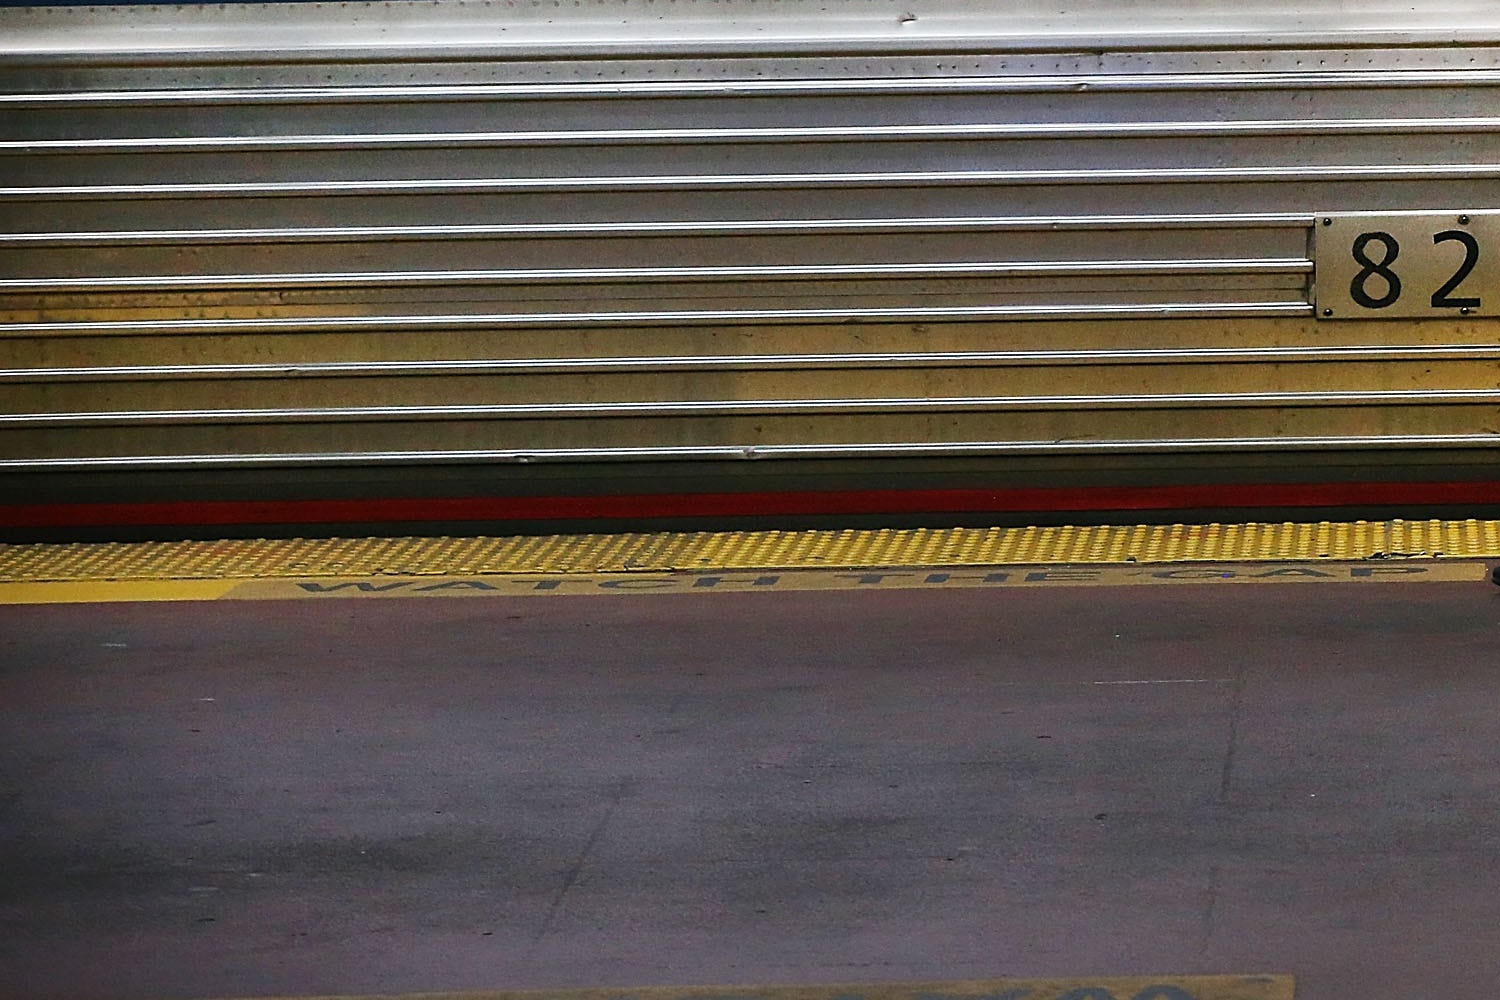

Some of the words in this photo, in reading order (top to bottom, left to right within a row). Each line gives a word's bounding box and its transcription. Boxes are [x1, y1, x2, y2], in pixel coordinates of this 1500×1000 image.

[296, 575, 780, 594] WATCH
[834, 571, 1102, 585] THE
[1151, 568, 1430, 580] GAP
